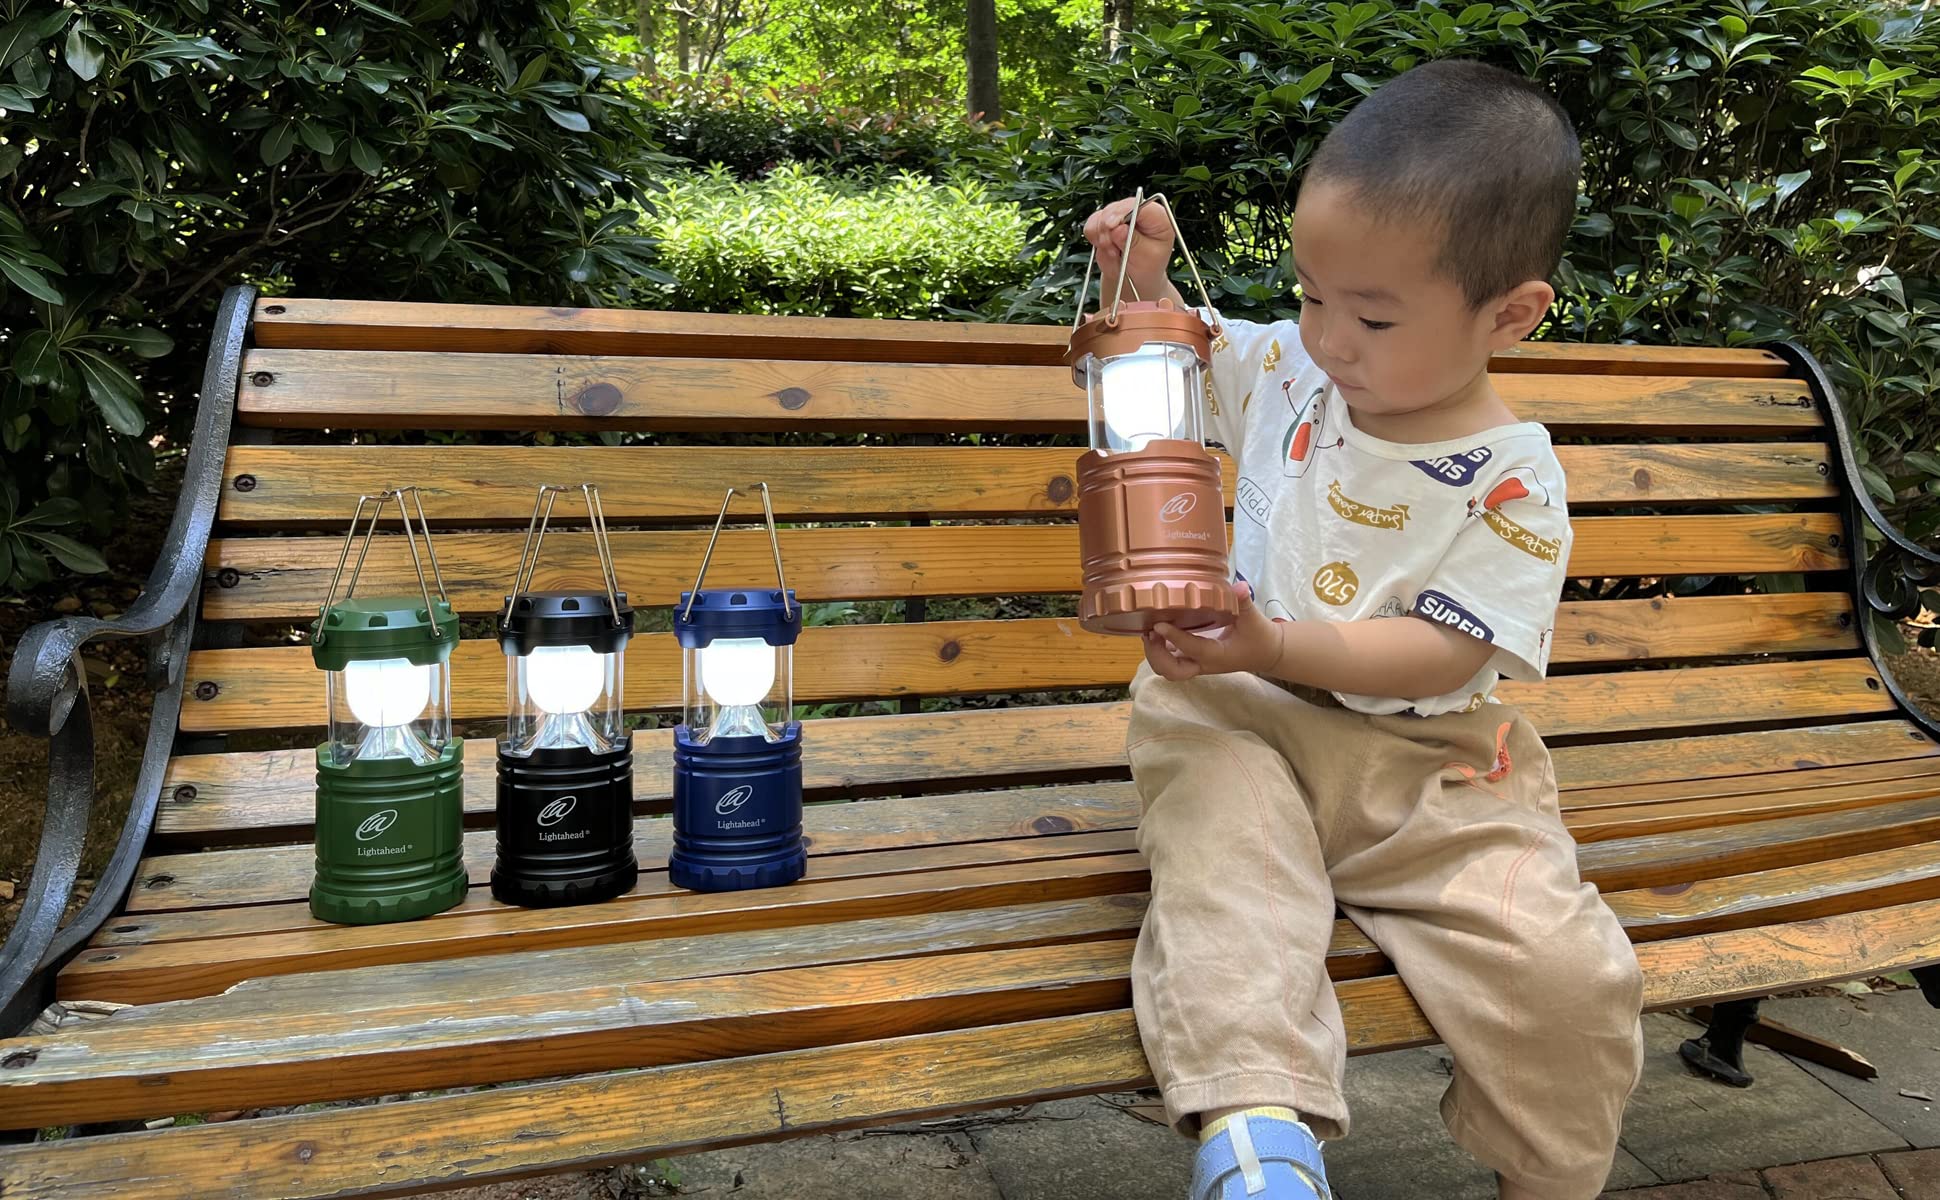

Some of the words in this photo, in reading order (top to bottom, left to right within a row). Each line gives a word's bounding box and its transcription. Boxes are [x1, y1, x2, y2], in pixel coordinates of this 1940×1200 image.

[1316, 569, 1357, 603] 520
[717, 818, 760, 830] Lightahead
[539, 830, 585, 843] Lightahead
[357, 845, 406, 857] Lightahead
